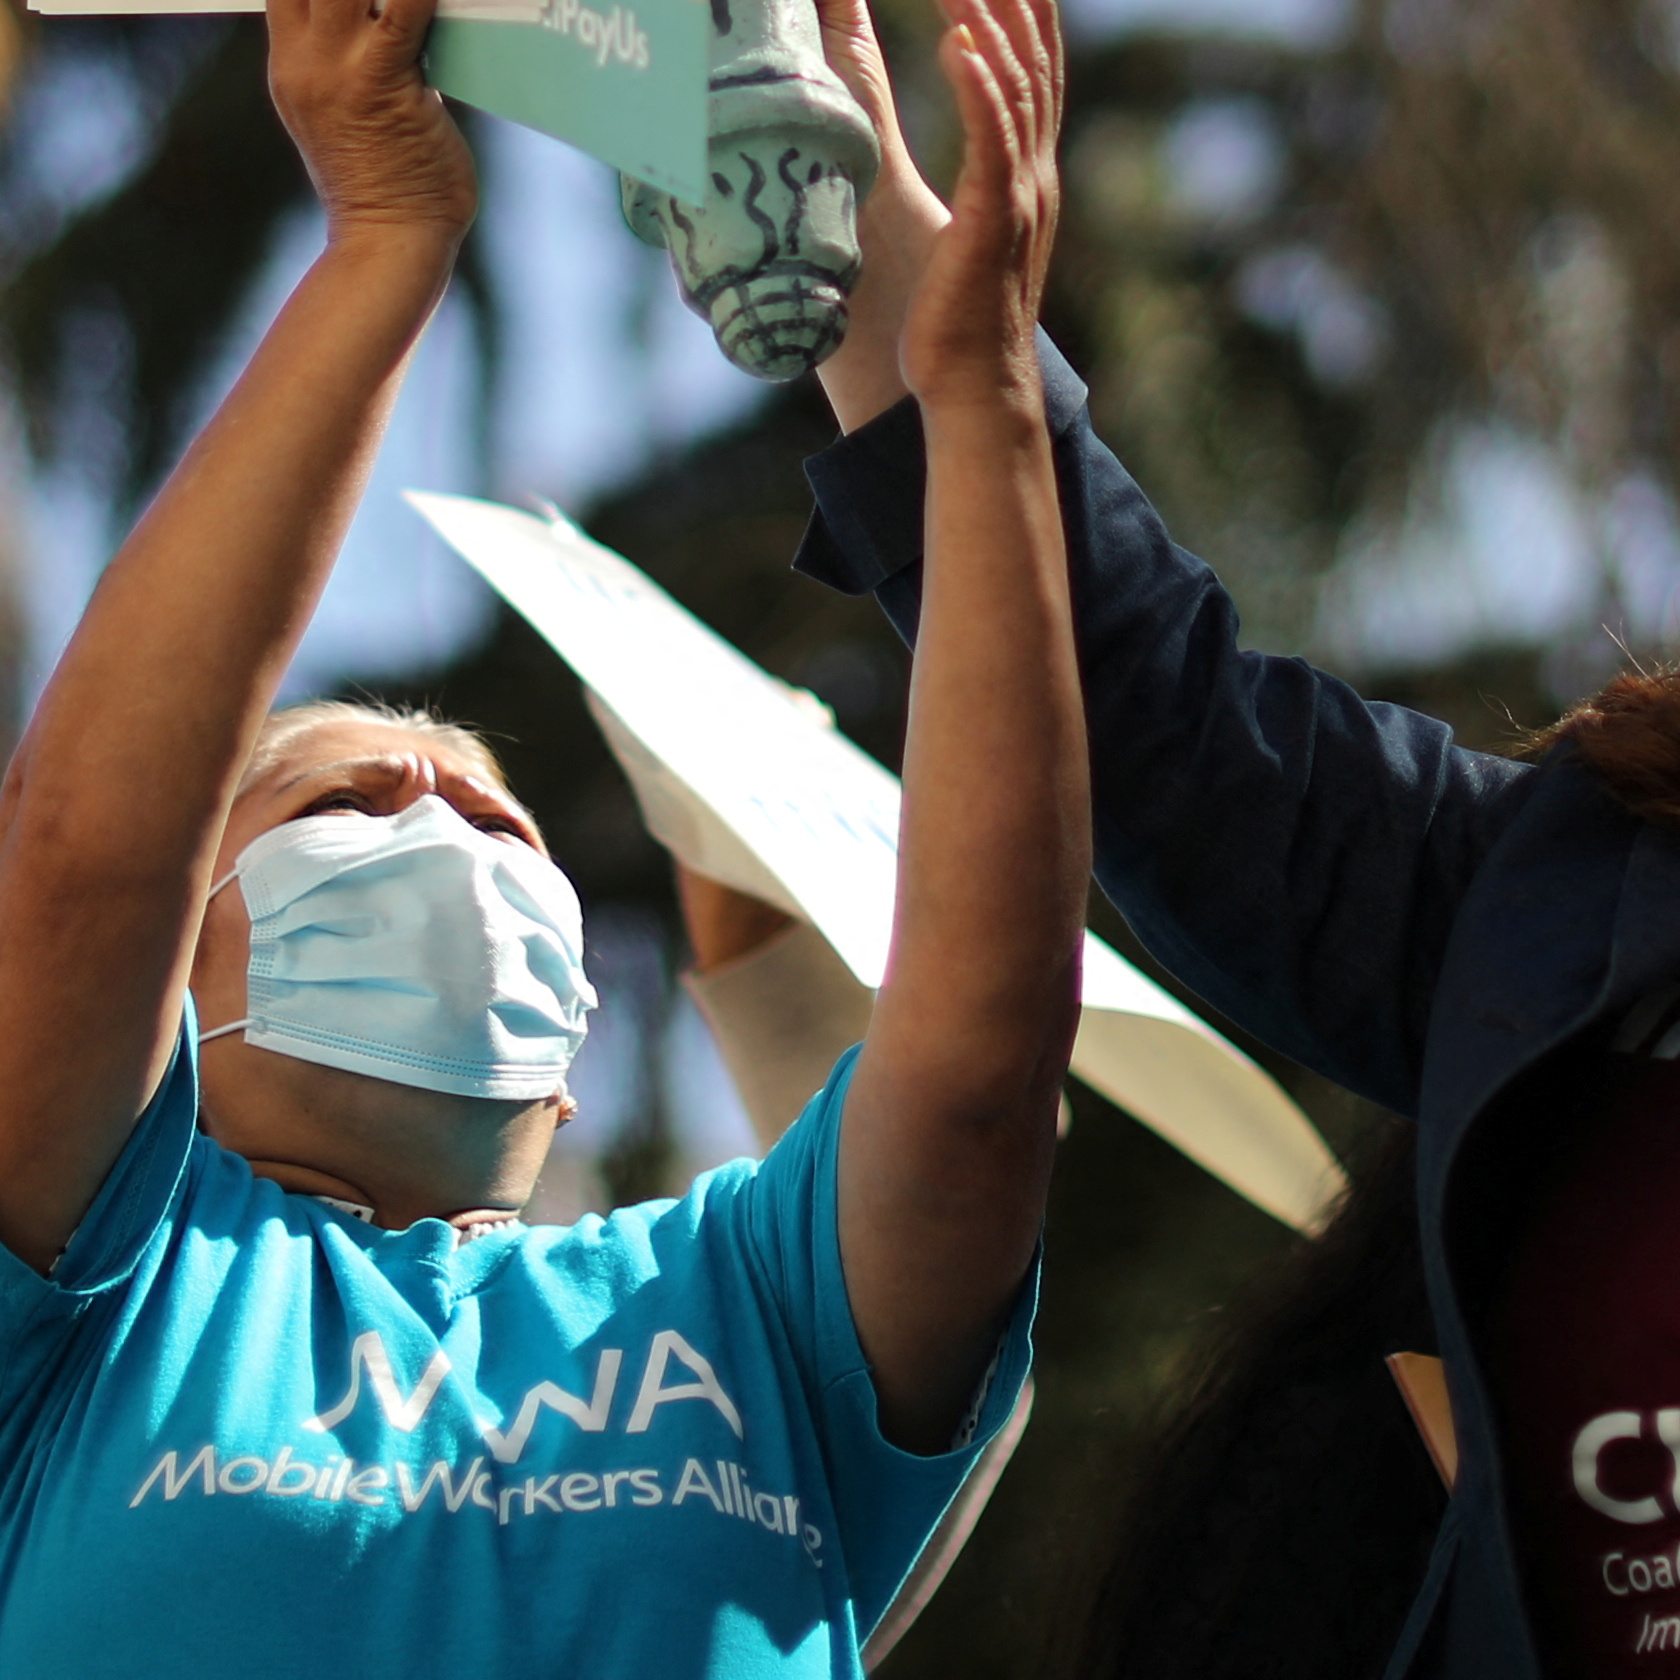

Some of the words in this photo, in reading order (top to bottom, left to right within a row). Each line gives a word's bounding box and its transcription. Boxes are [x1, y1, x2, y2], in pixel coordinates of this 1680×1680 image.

[302, 1328, 746, 1465] MWA
[128, 1444, 388, 1510] Mobile
[395, 1455, 664, 1526] Workers
[672, 1456, 823, 1569] Alliane
